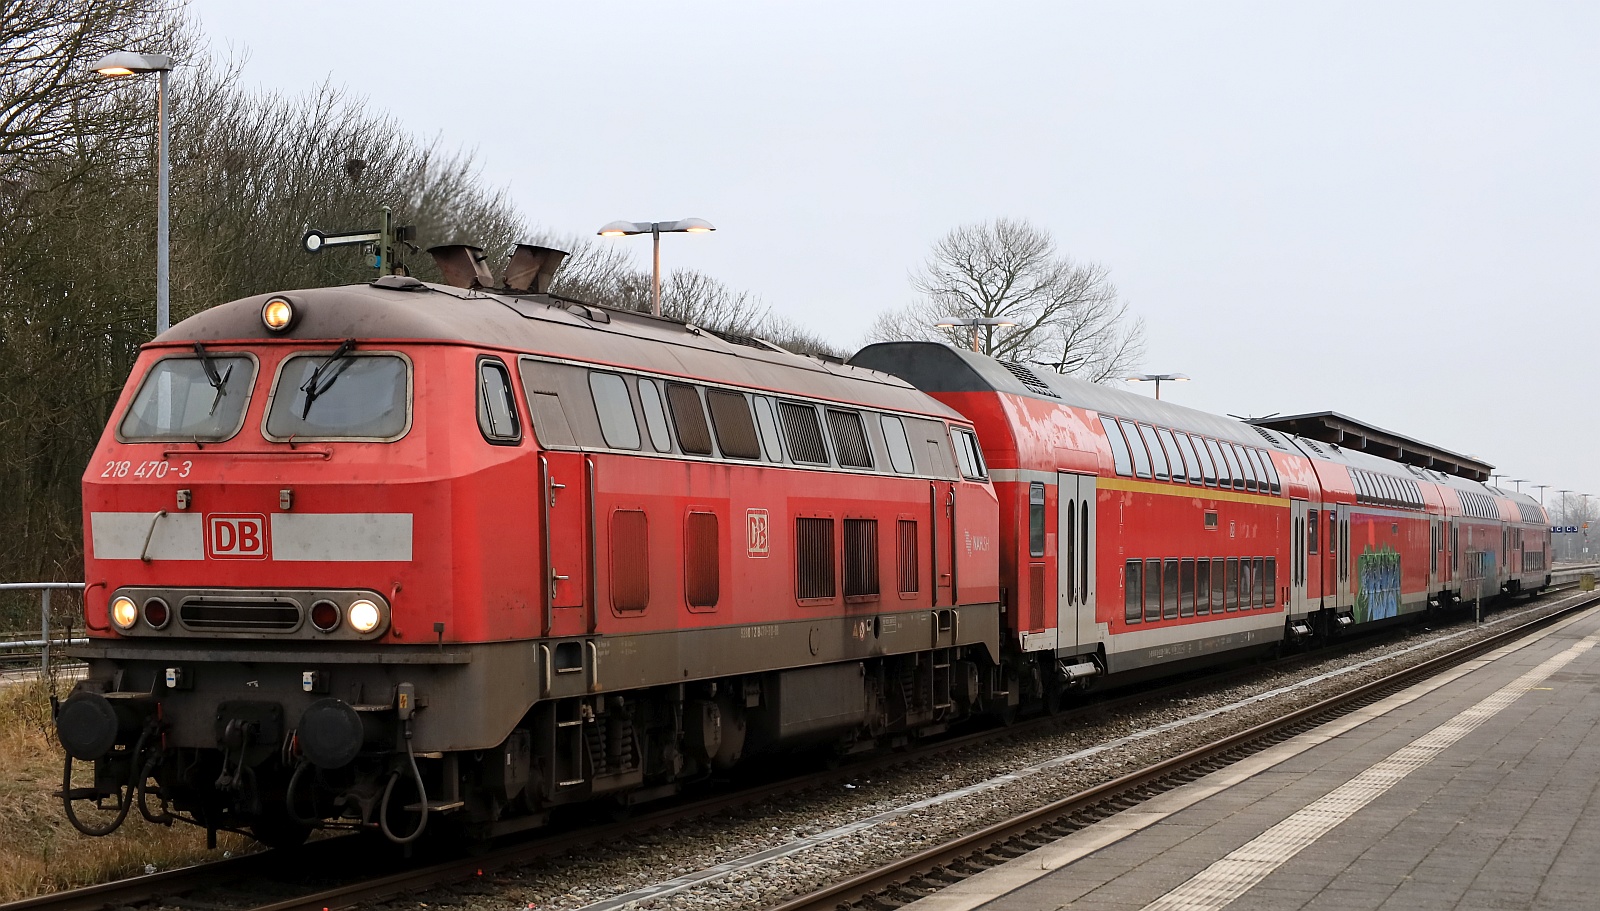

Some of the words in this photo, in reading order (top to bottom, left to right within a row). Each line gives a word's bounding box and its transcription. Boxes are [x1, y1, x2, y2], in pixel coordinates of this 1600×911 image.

[101, 460, 131, 478] 218
[134, 460, 193, 479] 470-3
[215, 521, 260, 552] DB
[750, 516, 767, 549] DB
